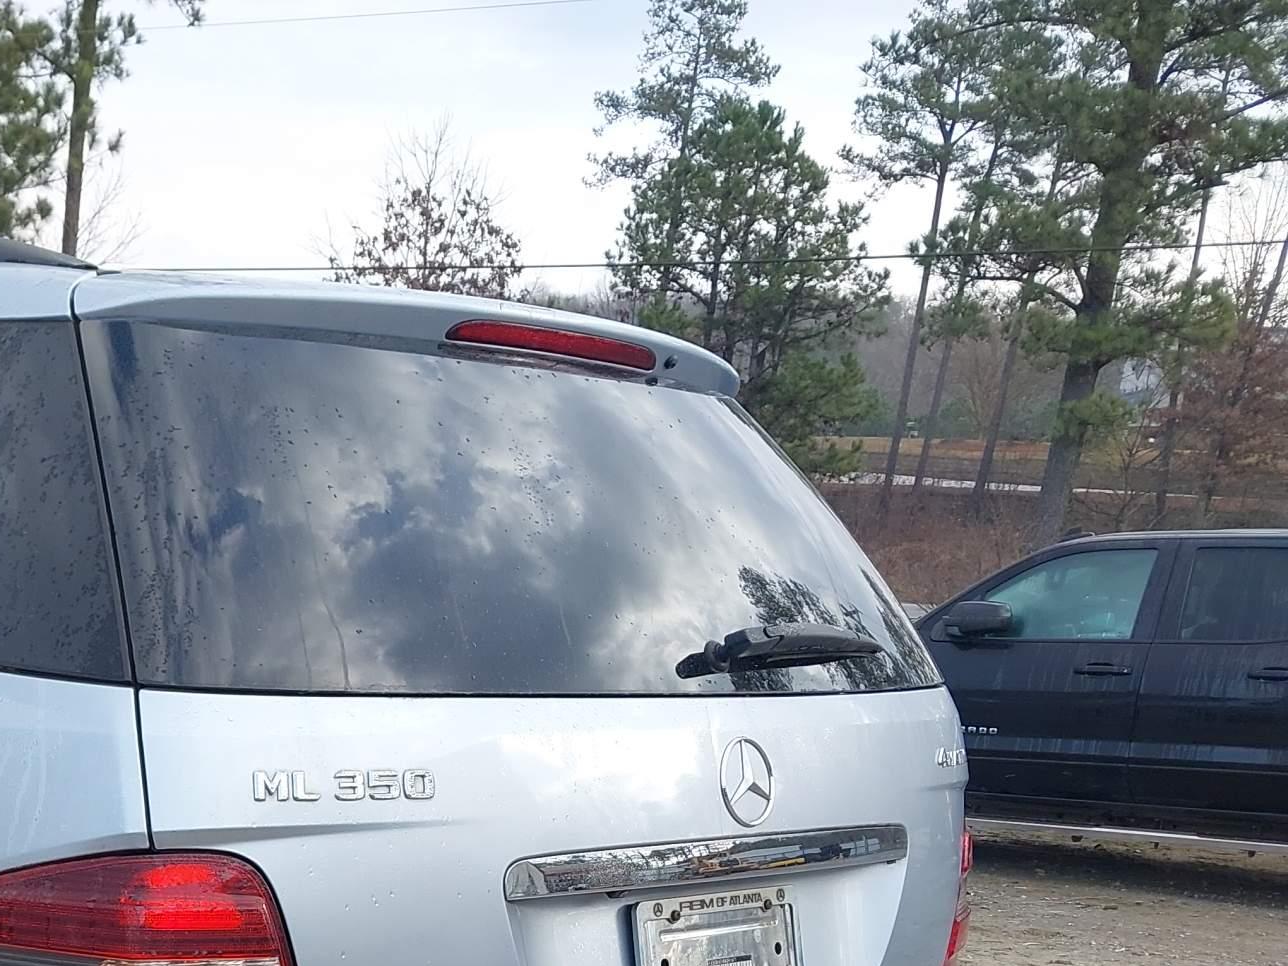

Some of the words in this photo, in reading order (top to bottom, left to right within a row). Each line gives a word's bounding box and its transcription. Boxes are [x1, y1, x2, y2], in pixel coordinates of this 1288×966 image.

[252, 769, 321, 802] ML
[333, 768, 436, 801] 350
[716, 896, 727, 907] OF
[729, 892, 763, 906] ATLANTA
